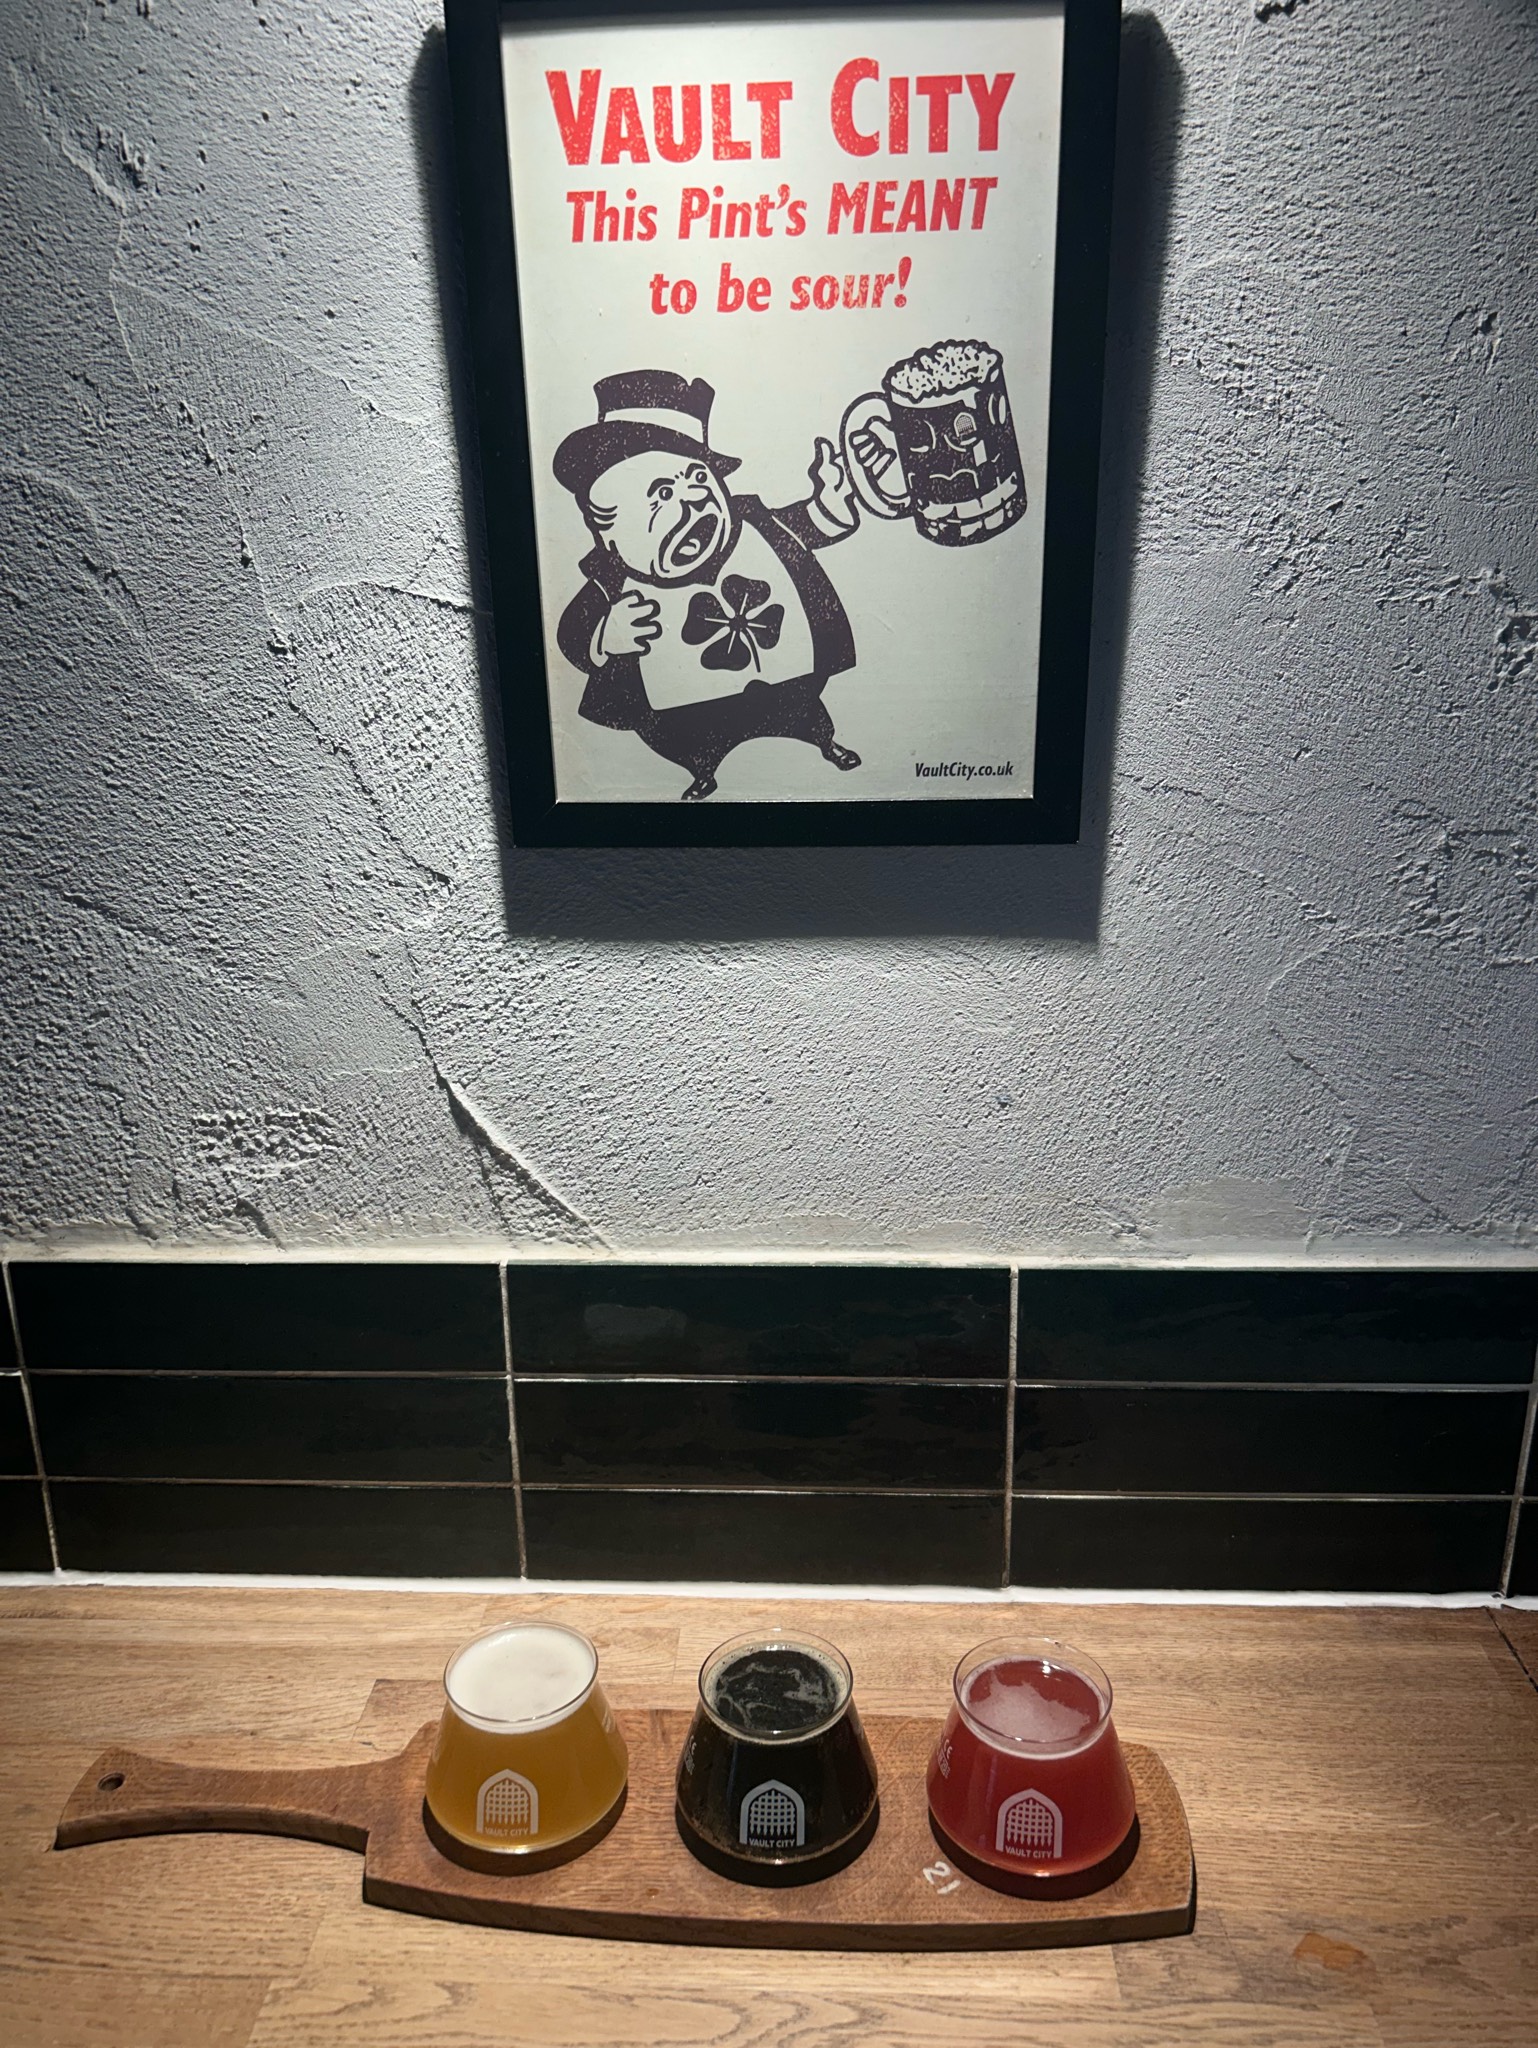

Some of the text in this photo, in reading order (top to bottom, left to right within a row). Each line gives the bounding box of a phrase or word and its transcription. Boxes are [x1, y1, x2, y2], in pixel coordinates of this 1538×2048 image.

[545, 57, 1016, 166] VAULT CITY
[566, 176, 998, 243] This Pint's MEANT
[649, 256, 913, 314] to be sour!
[915, 761, 1014, 781] VaultCity.co.uk
[485, 1827, 528, 1836] VAULT CITY
[749, 1838, 795, 1848] VAULT CITY
[1006, 1845, 1052, 1858] VAULT CITY
[922, 1860, 961, 1895] 21
